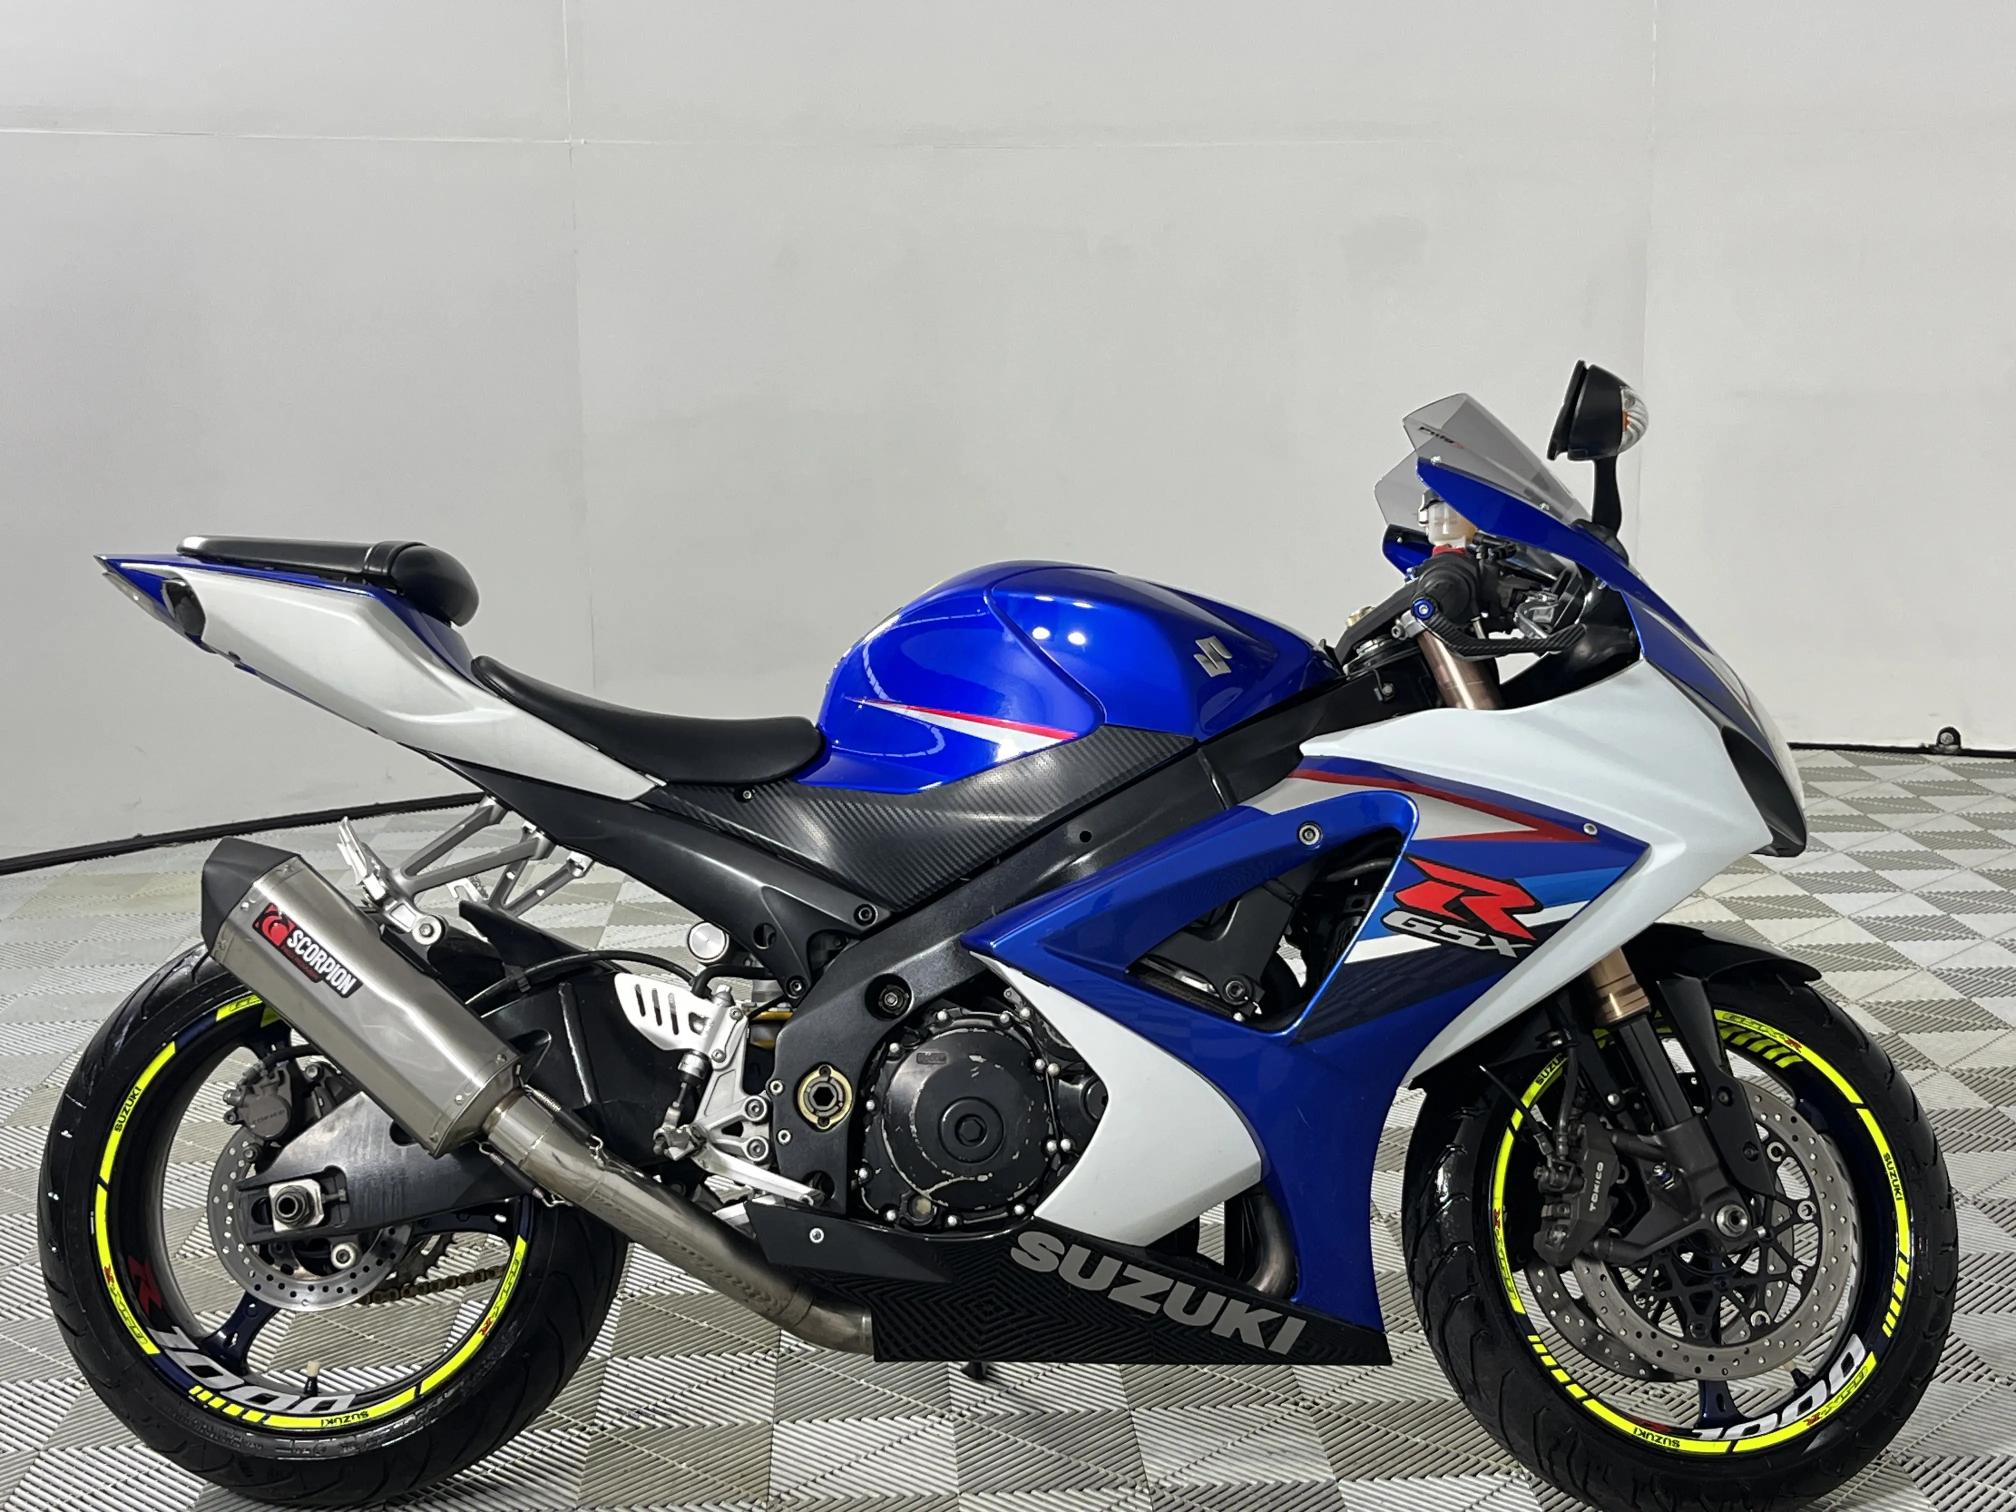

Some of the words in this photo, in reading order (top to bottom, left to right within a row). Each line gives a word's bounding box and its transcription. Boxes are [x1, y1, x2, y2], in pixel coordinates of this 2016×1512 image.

[1381, 909, 1534, 959] GSX
[286, 928, 357, 995] SCORPION
[114, 1085, 142, 1133] SUZUKI
[1588, 1161, 1604, 1212] TOKICO
[1882, 1151, 1904, 1202] SUZUKI
[1010, 1230, 1307, 1355] SUZUKI
[146, 1325, 356, 1414] 1000
[1691, 1333, 1867, 1441] 1000
[319, 1411, 369, 1428] SUZUKI
[1632, 1426, 1681, 1448] SUZUKI
